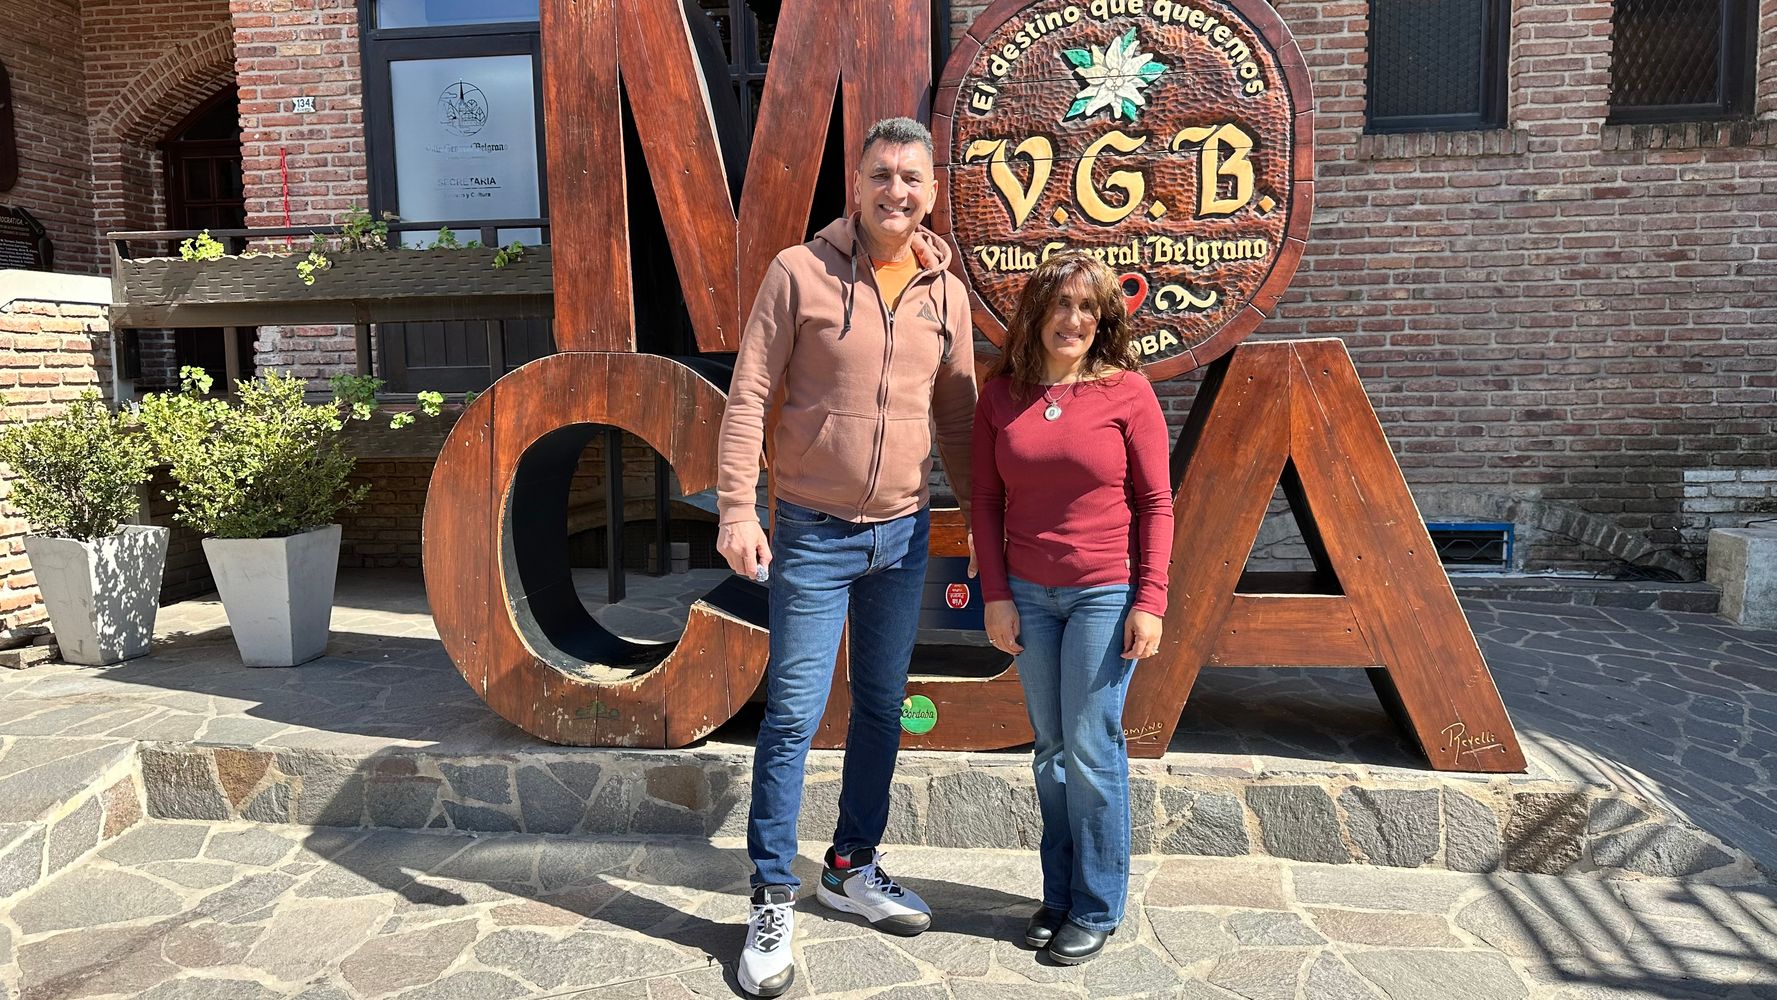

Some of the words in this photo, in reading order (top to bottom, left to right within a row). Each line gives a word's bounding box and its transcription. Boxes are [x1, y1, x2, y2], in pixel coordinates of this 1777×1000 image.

[972, 82, 998, 111] El
[990, 5, 1080, 78] destino
[1090, 0, 1143, 20] que
[1152, 0, 1266, 97] queremos
[296, 98, 310, 108] 134
[973, 245, 1037, 271] Villa
[1146, 235, 1268, 266] Belgrano
